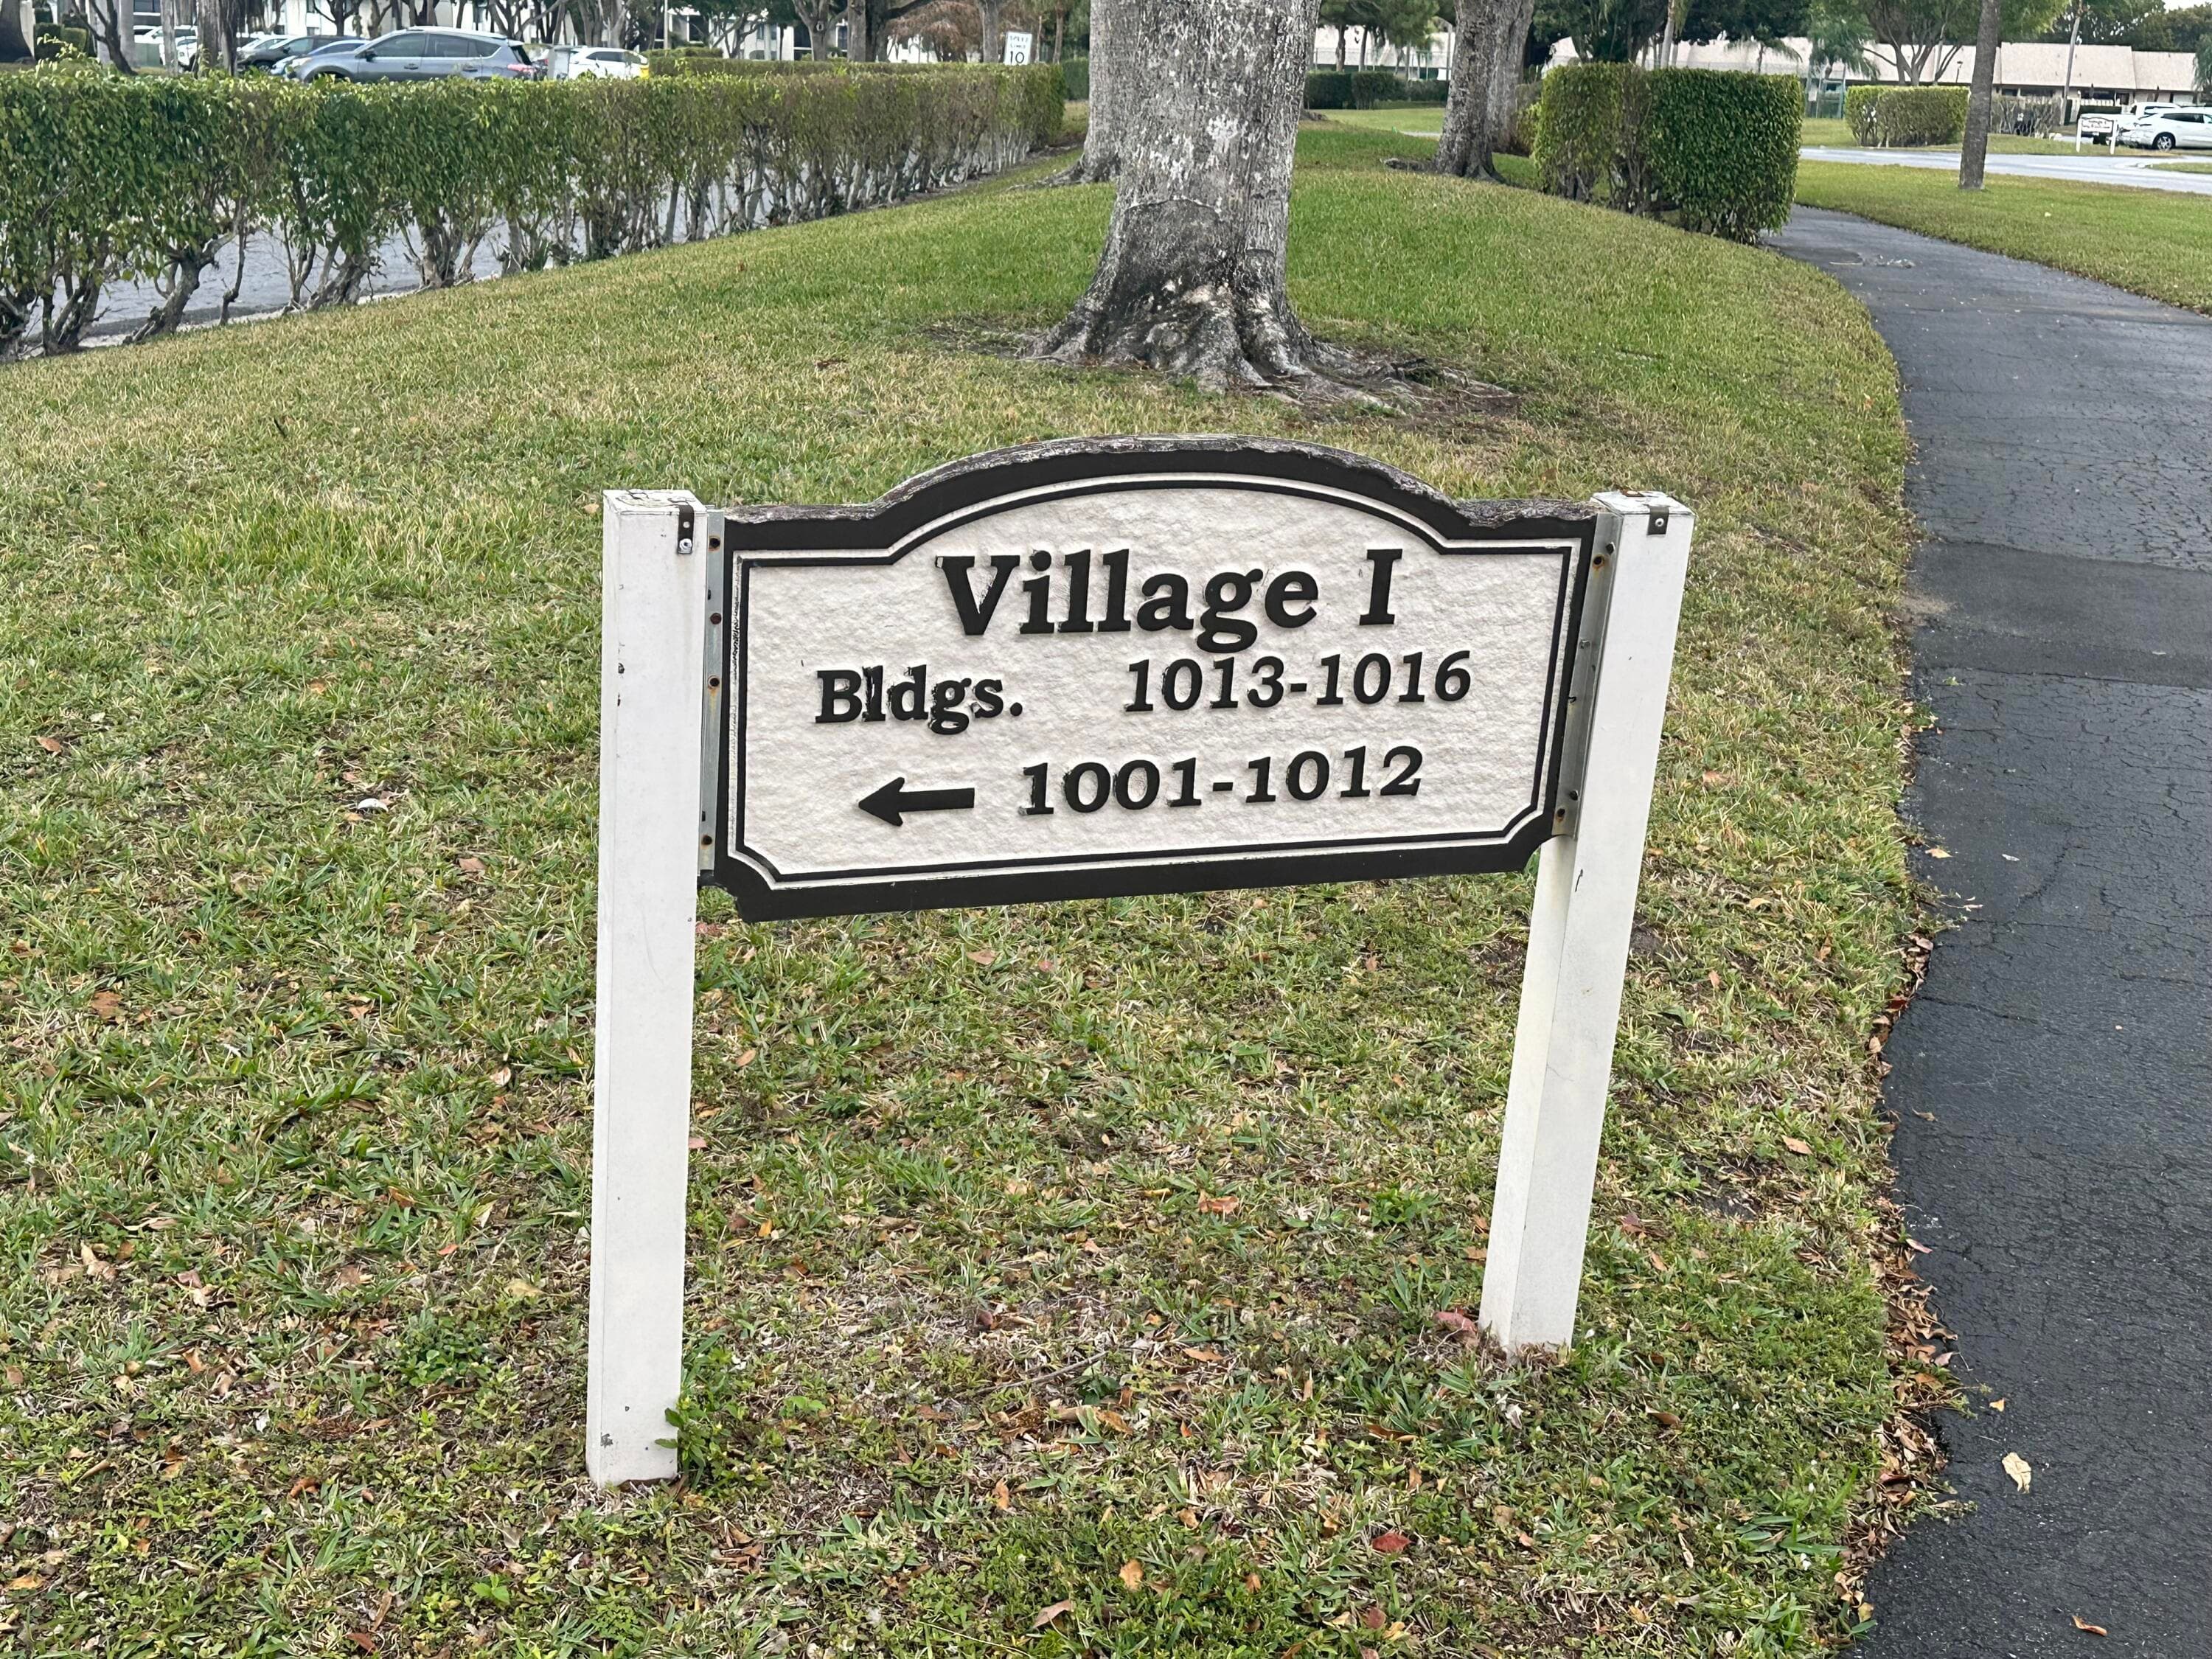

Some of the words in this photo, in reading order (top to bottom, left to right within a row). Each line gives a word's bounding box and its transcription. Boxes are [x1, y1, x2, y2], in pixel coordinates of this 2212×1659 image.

[1010, 51, 1024, 64] 10
[934, 548, 1318, 654] Village
[1359, 548, 1403, 626] I
[814, 664, 1023, 736] Bldgs.
[1124, 650, 1472, 712] 1013-1016
[1022, 745, 1424, 816] 1001-1012
